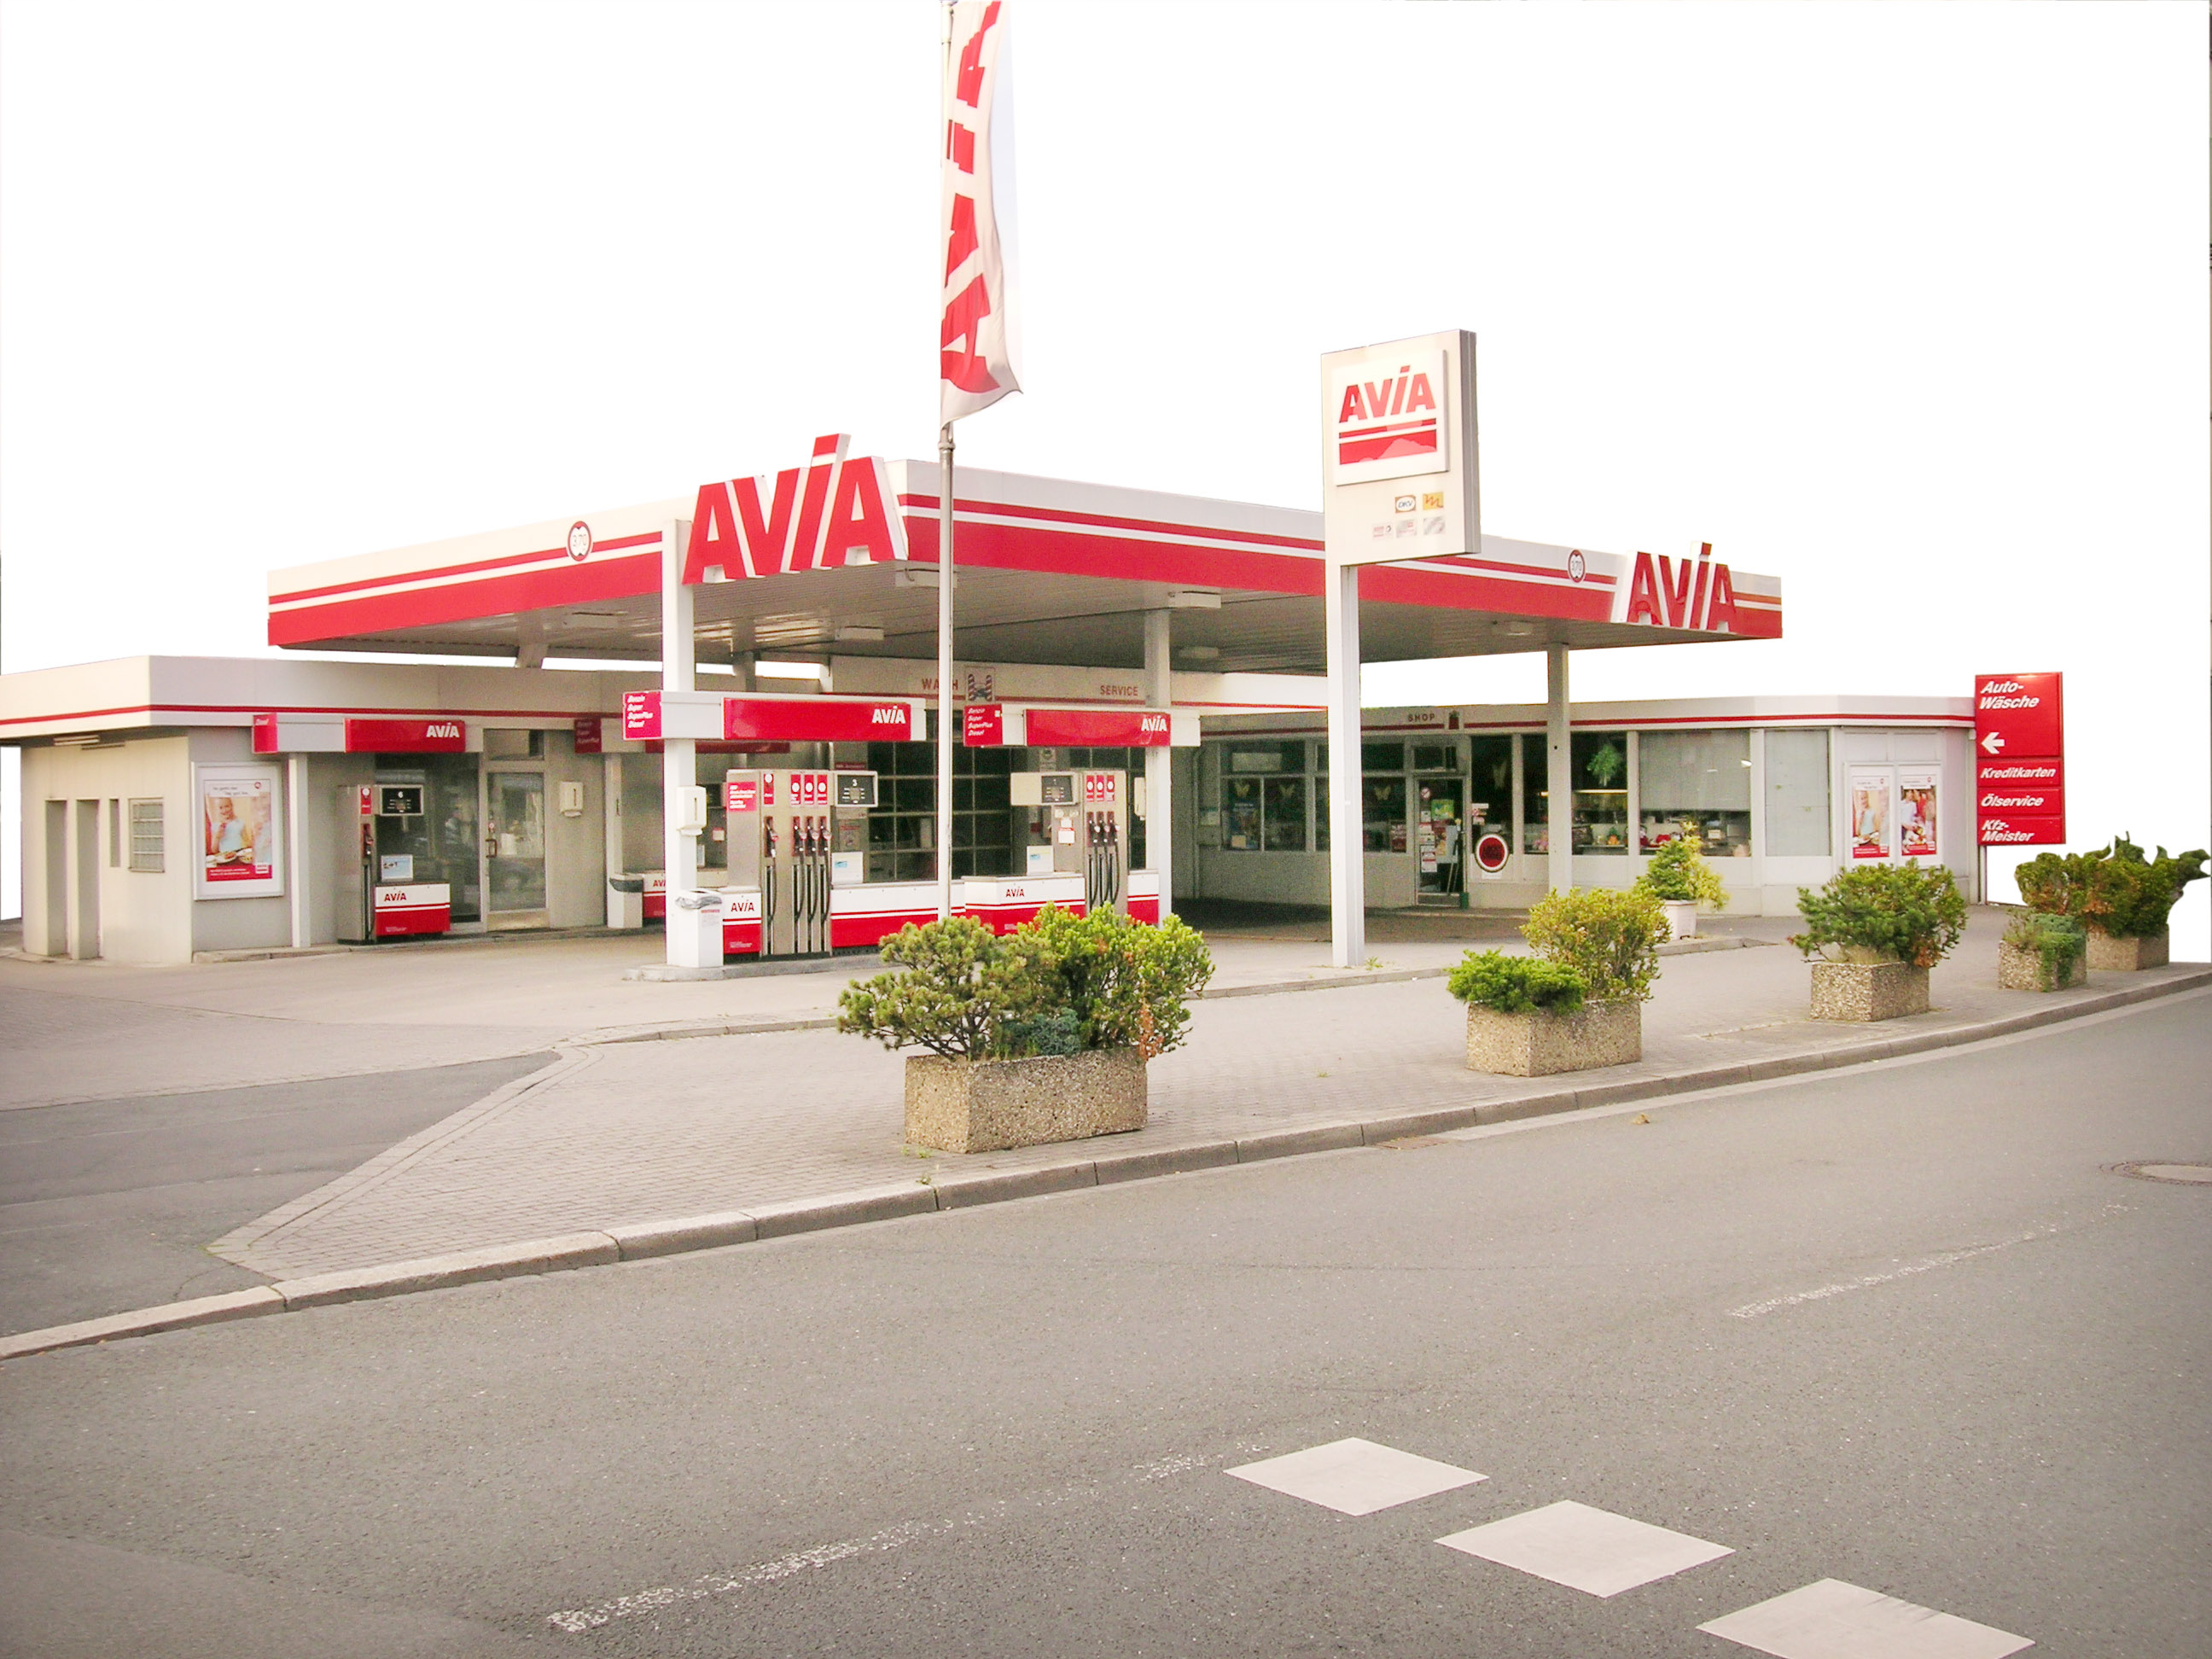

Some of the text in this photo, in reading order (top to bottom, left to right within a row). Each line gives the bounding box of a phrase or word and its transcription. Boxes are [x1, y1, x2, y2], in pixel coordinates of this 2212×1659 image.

[1339, 365, 1436, 423] AVIA
[683, 433, 905, 585] AVIA
[1623, 541, 1737, 632] AVIA
[922, 678, 958, 690] WAH
[1100, 684, 1138, 696] SERVICE
[1980, 680, 2024, 694] Auto-
[1979, 695, 2040, 710] Wäsche
[871, 705, 906, 725] AVIA
[1408, 713, 1435, 723] SHOP
[426, 722, 460, 738] AVIA
[1140, 715, 1167, 732] AVIA
[1980, 766, 2056, 779] Kreditkarten
[1981, 793, 2044, 807] Ölservice
[1982, 819, 2009, 831] Kfz-
[1982, 830, 2034, 842] Meister
